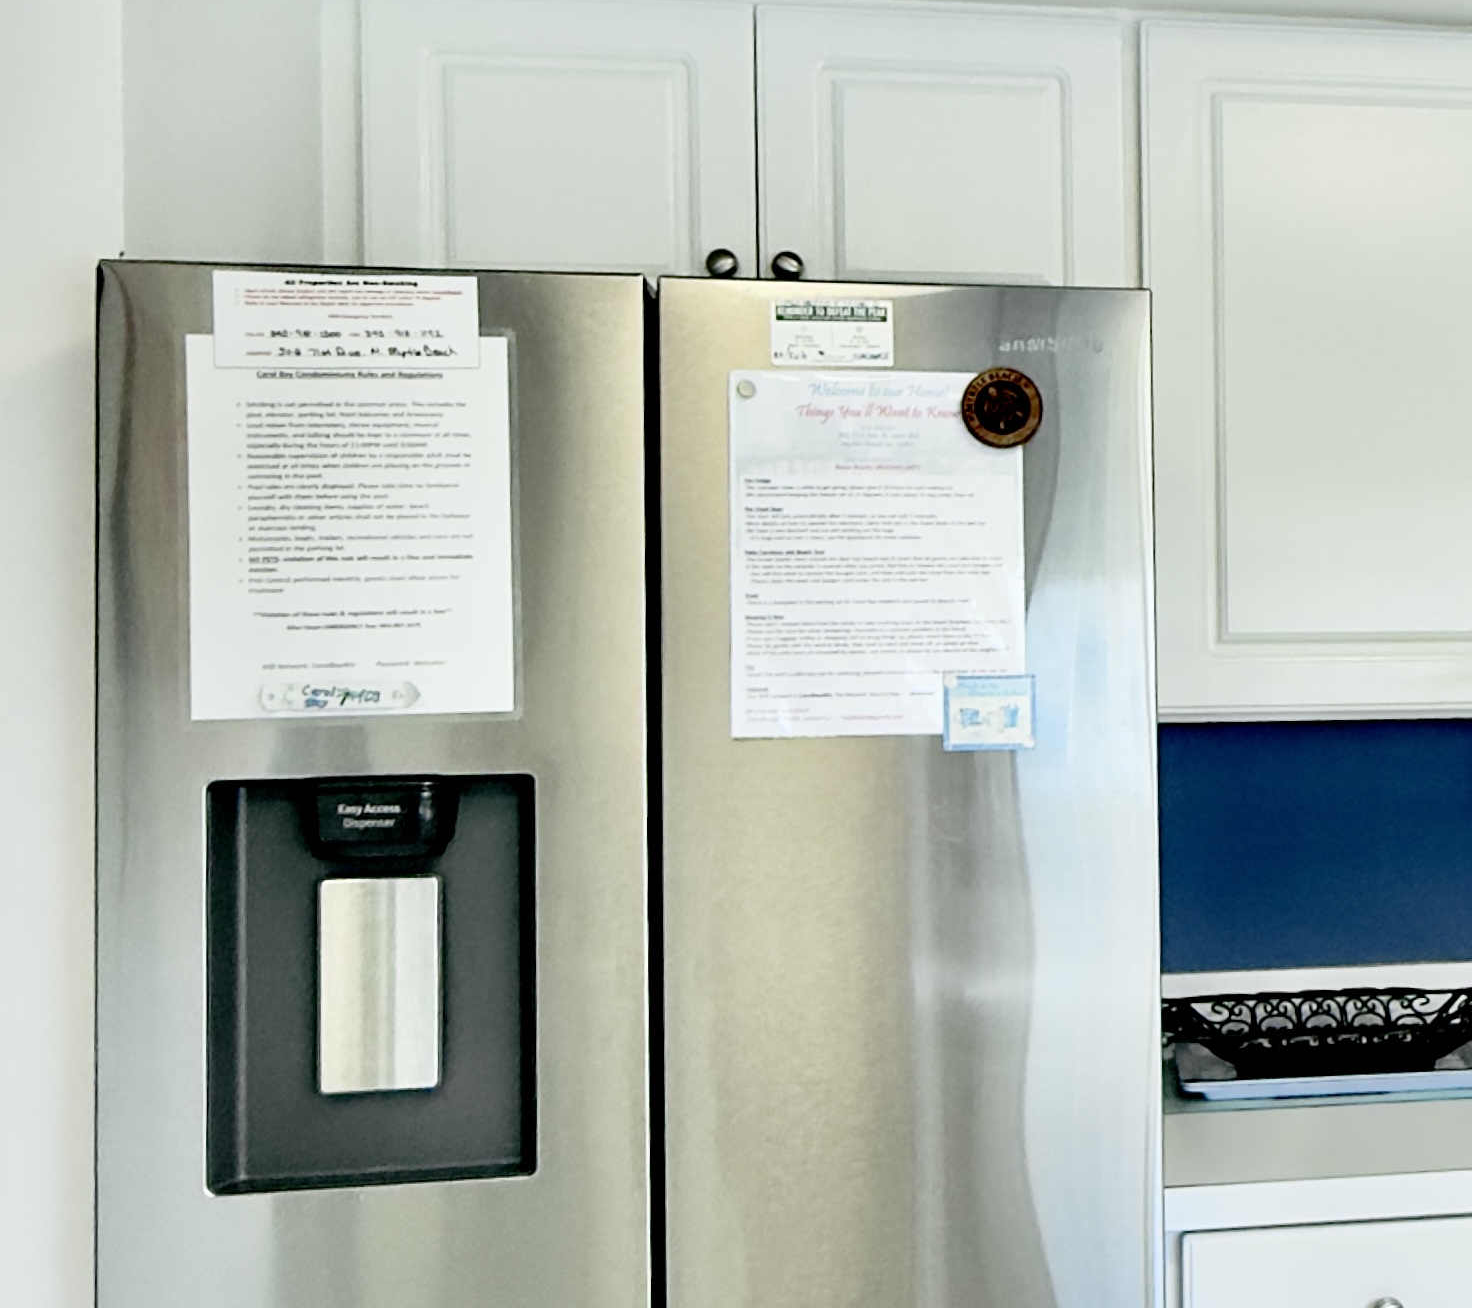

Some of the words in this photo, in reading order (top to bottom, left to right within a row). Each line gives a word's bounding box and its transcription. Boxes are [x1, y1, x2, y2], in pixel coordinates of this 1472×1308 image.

[808, 381, 866, 398] Welcome
[867, 380, 880, 398] to
[796, 402, 835, 424] Things
[876, 405, 910, 419] Want
[911, 406, 922, 419] to
[336, 803, 362, 815] Easy
[364, 802, 402, 814] Access
[342, 817, 396, 830] Dispenser
